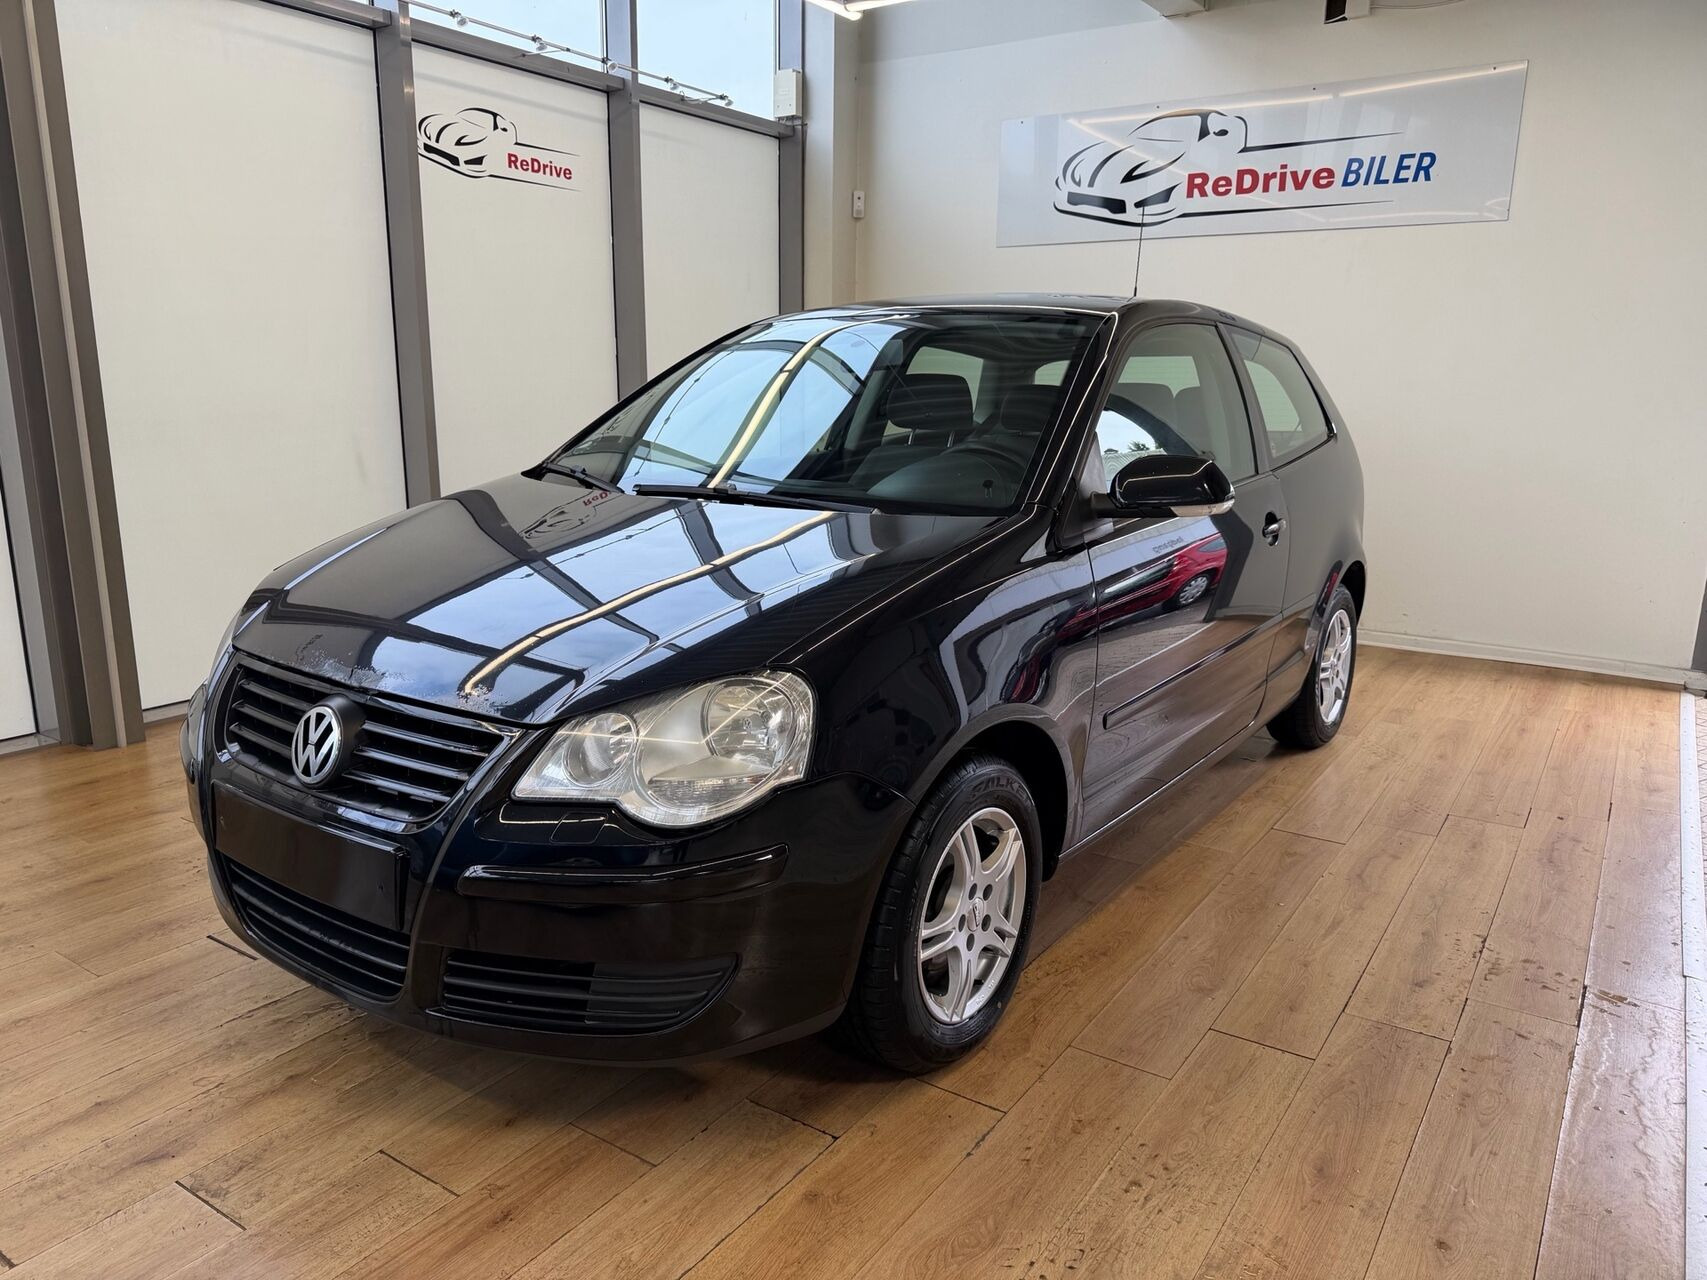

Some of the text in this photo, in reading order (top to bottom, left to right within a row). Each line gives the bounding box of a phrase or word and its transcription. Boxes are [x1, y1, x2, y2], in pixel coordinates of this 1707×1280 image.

[506, 152, 573, 180] ReDrive
[1186, 152, 1437, 199] ReDrive BILER
